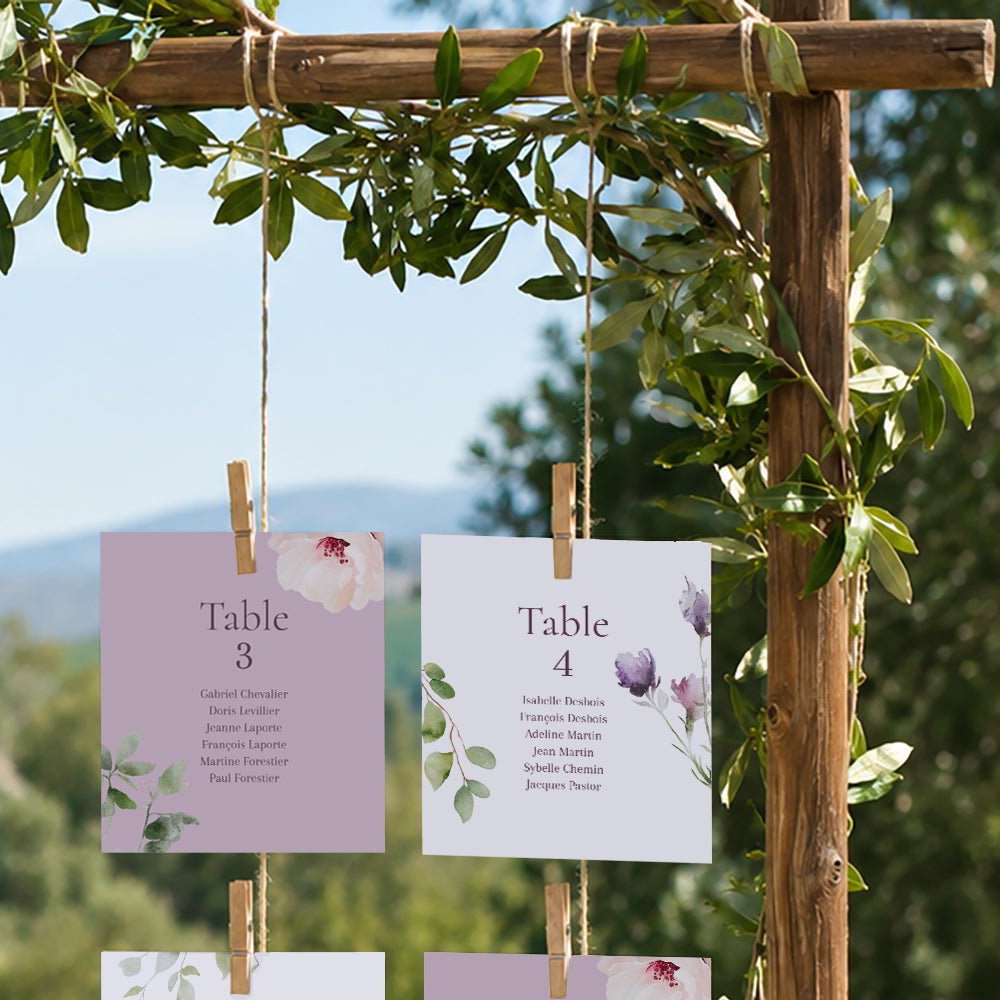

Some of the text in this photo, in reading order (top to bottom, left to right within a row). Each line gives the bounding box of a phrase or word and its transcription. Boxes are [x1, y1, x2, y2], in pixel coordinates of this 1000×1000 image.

[200, 598, 289, 631] Table
[518, 604, 609, 638] Table
[236, 642, 253, 670] 3
[552, 649, 573, 677] 4
[200, 689, 289, 699] Gabriel Chevalier
[209, 706, 280, 716] Doris Levillier
[205, 723, 282, 735] Jeanne Laporte
[525, 729, 602, 741] Adeline Martin
[202, 739, 287, 752] François Laporte
[532, 746, 594, 758] Jean Martin
[200, 756, 289, 766] Martine Forestier
[523, 762, 604, 775] Sybelle Chemin
[210, 773, 280, 783] Paul Forestier
[525, 779, 602, 792] Jacques Pastor
